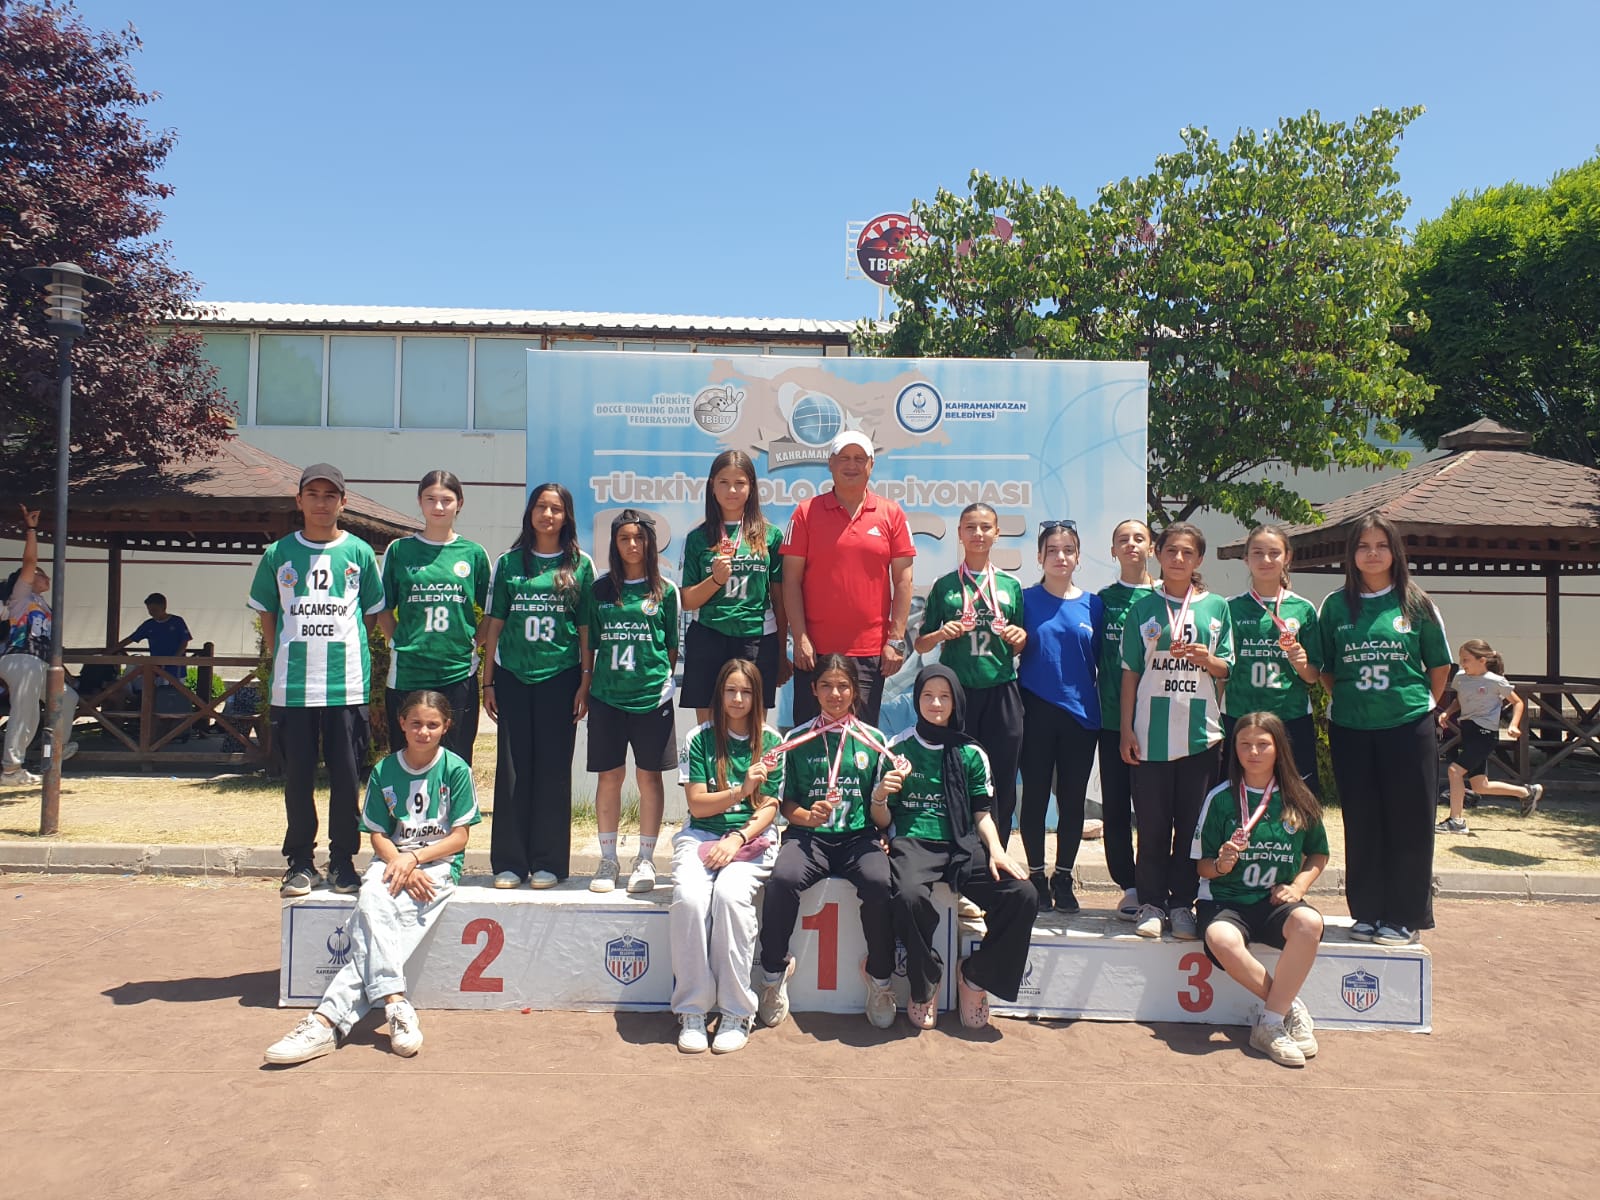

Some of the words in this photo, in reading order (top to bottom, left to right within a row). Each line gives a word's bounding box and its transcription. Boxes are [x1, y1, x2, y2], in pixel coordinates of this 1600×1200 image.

[596, 405, 623, 414] BOCCE
[625, 406, 665, 415] BOWLING
[668, 406, 691, 415] DART
[655, 394, 691, 405] TÜRKİYE
[945, 402, 1027, 411] KAHRAMANKAZAN
[630, 415, 691, 424] FEDERASYONU
[945, 410, 995, 420] BELEDİYESİ
[775, 449, 831, 462] KAHRAMAN
[592, 472, 707, 502] TÜRKİY
[757, 480, 816, 502] OLO
[311, 569, 329, 590] 12
[411, 583, 463, 592] ALAÇAM
[424, 606, 450, 633] 18
[524, 615, 556, 642] 03
[302, 624, 335, 637] BOCCE
[967, 631, 993, 657] 12
[1242, 638, 1280, 648] ALAÇA
[1345, 640, 1403, 652] ALAÇAM
[610, 644, 637, 672] 14
[1152, 657, 1208, 674] ALAÇAMSPO
[1250, 661, 1282, 689] 02
[1355, 664, 1390, 691] 35
[1164, 679, 1197, 693] BOCCE
[413, 792, 424, 815] 9
[1242, 863, 1278, 889] 04
[459, 917, 505, 993] 2
[802, 902, 839, 991] 1
[1177, 951, 1214, 1013] 3
